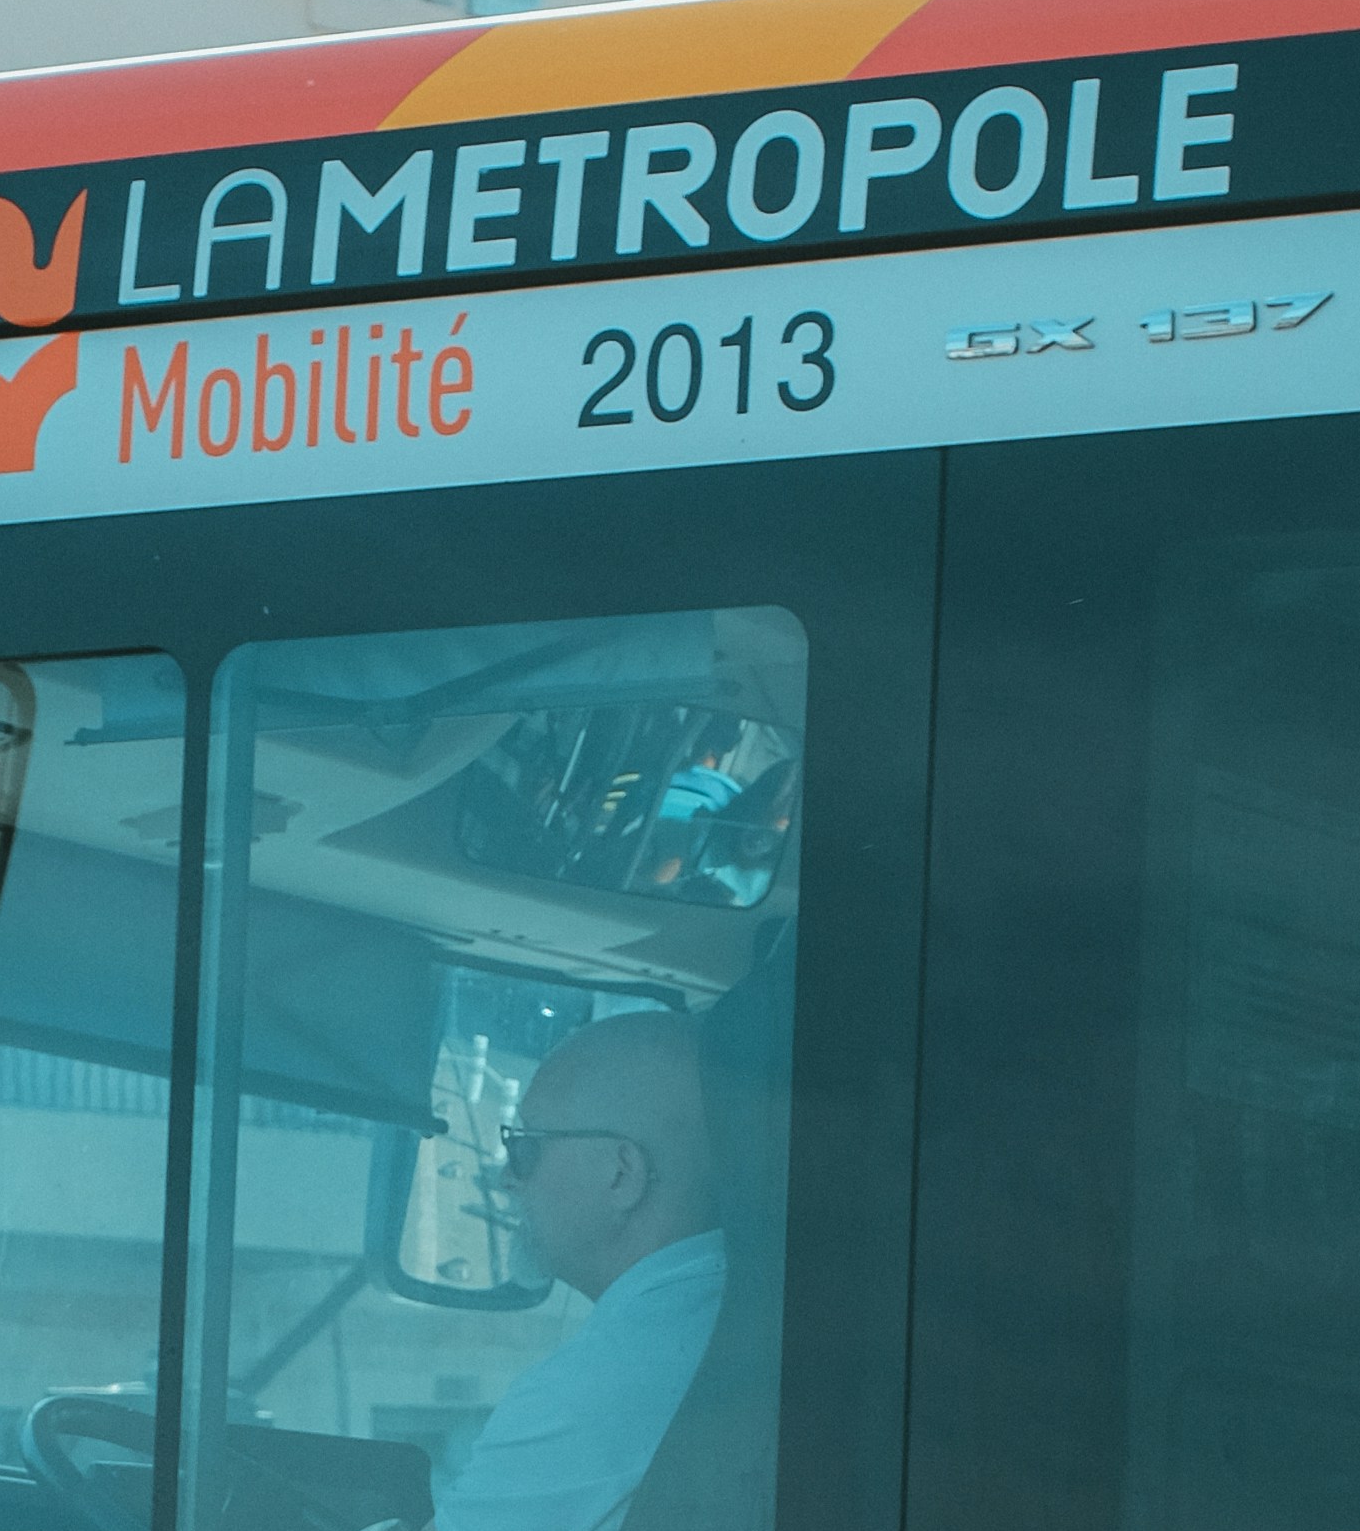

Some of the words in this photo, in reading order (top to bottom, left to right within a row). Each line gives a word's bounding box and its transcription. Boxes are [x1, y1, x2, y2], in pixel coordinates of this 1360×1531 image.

[578, 310, 836, 428] 2013
[946, 322, 1096, 360] GX
[1140, 292, 1335, 343] 137
[118, 313, 473, 463] Mobilité
